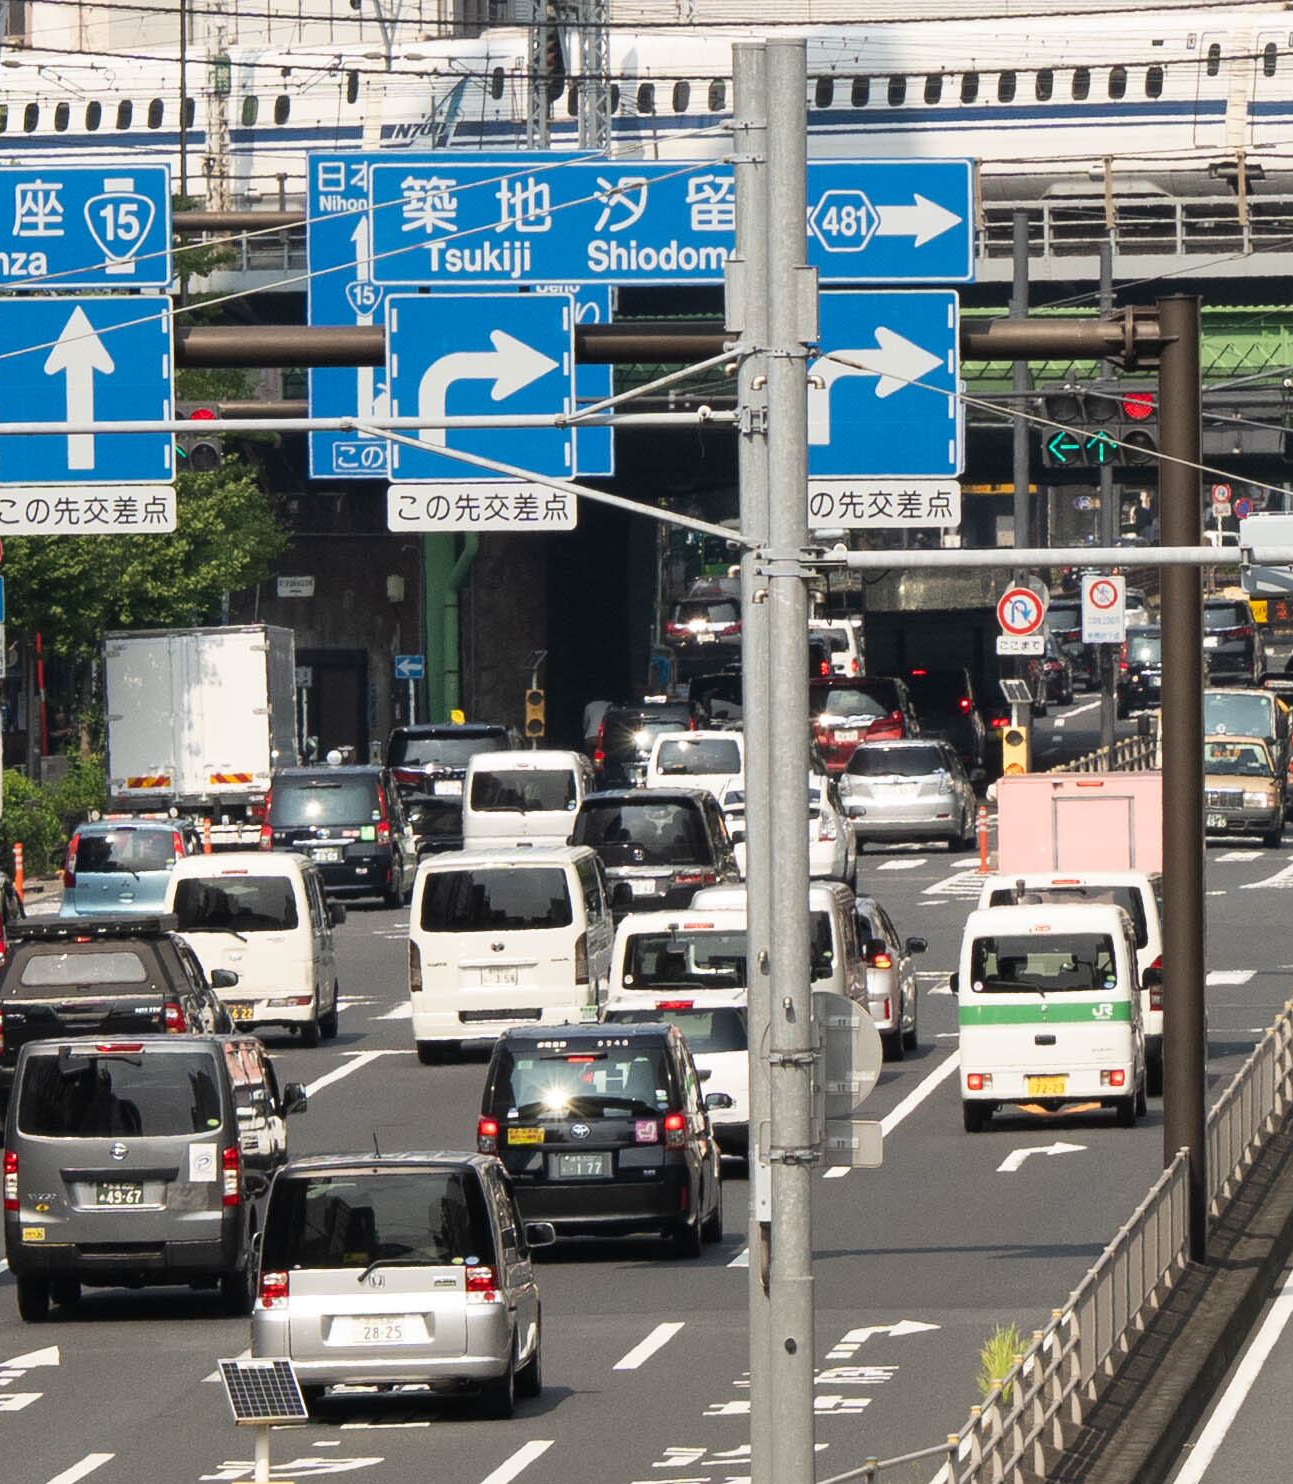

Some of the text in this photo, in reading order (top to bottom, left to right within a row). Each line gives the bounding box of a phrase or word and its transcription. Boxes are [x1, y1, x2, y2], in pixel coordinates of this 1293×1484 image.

[400, 174, 736, 233] 築地 汐留
[98, 204, 140, 244] 15
[821, 207, 870, 237] 481
[428, 240, 735, 277] Tsukiji Shiodom
[353, 284, 376, 306] 15
[397, 492, 568, 522] この先交差点
[810, 490, 953, 519] の先交差点
[1091, 1003, 1113, 1016] JR
[106, 1190, 142, 1204] 49-67
